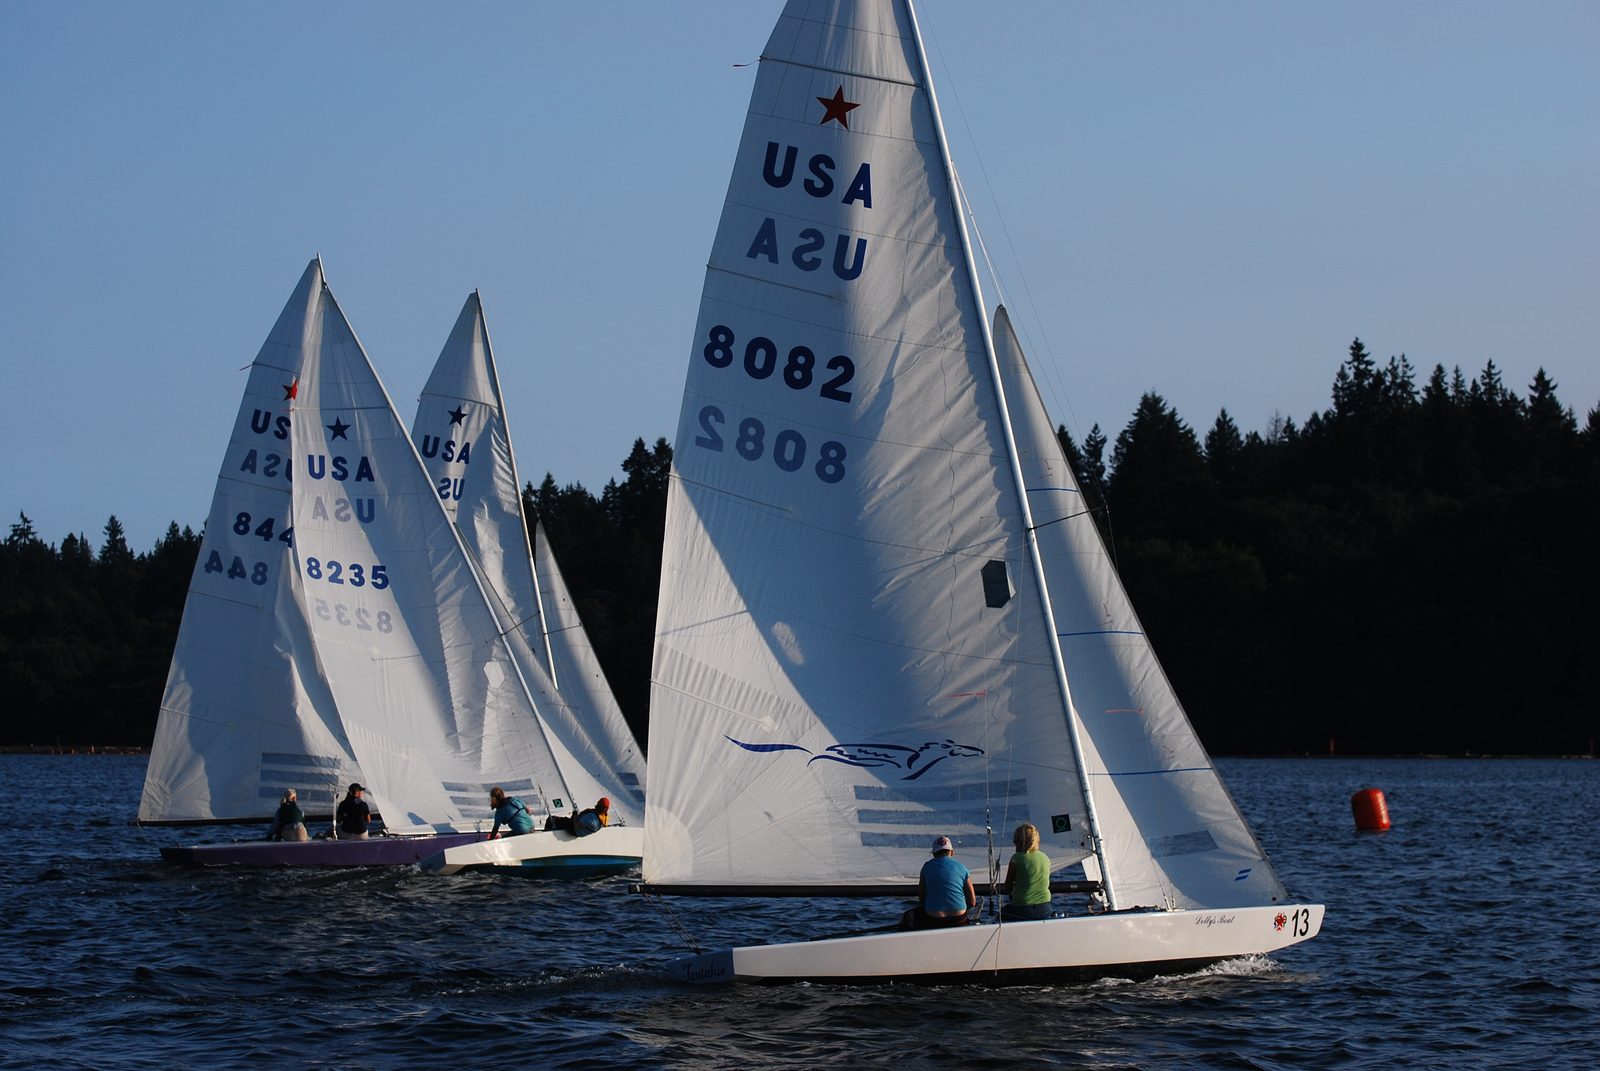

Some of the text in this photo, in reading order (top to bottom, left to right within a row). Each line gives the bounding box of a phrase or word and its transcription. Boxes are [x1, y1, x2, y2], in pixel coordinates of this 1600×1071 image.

[762, 141, 873, 209] USA
[703, 324, 856, 403] 8082
[251, 409, 292, 440] US
[421, 434, 470, 465] USA
[308, 454, 375, 482] USA
[306, 557, 390, 590] 8235
[1292, 908, 1310, 937] 13
